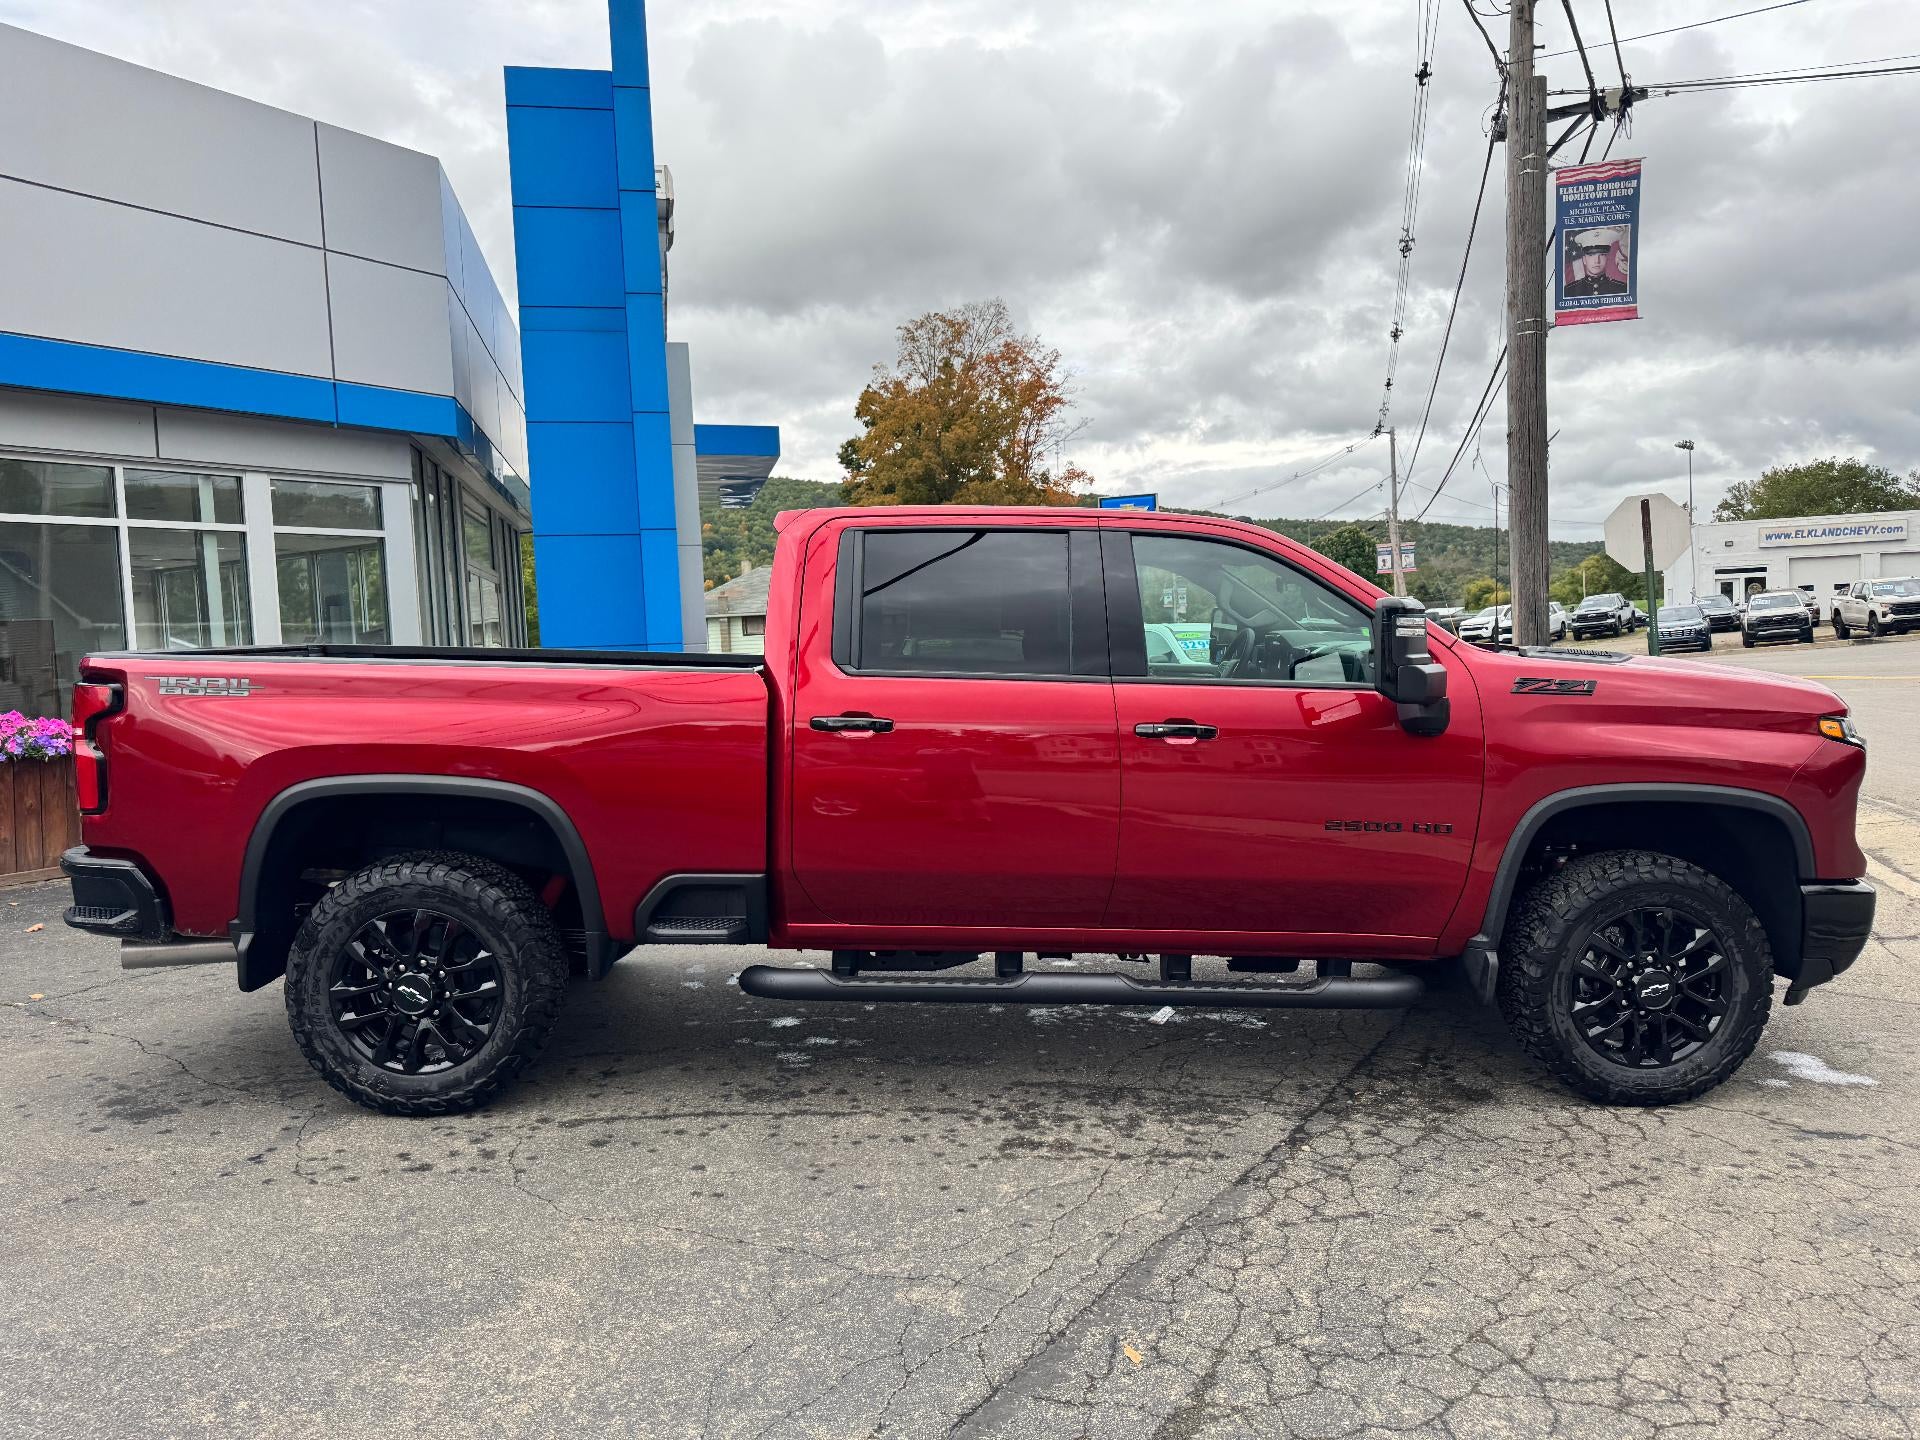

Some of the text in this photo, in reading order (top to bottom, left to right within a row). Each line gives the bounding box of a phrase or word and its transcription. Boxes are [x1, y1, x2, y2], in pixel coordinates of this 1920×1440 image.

[1560, 180, 1637, 195] ELKLAND BOROUGH
[1562, 187, 1634, 202] HOMETOWN HERO
[1569, 204, 1626, 216] MICHAEL PLANK
[1578, 214, 1606, 224] MARINE
[1606, 212, 1631, 221] CORPS
[1765, 525, 1904, 541] www.ELKLANDCHEVY.com
[1510, 677, 1598, 696] Z71
[1324, 820, 1453, 833] 2500 HD
